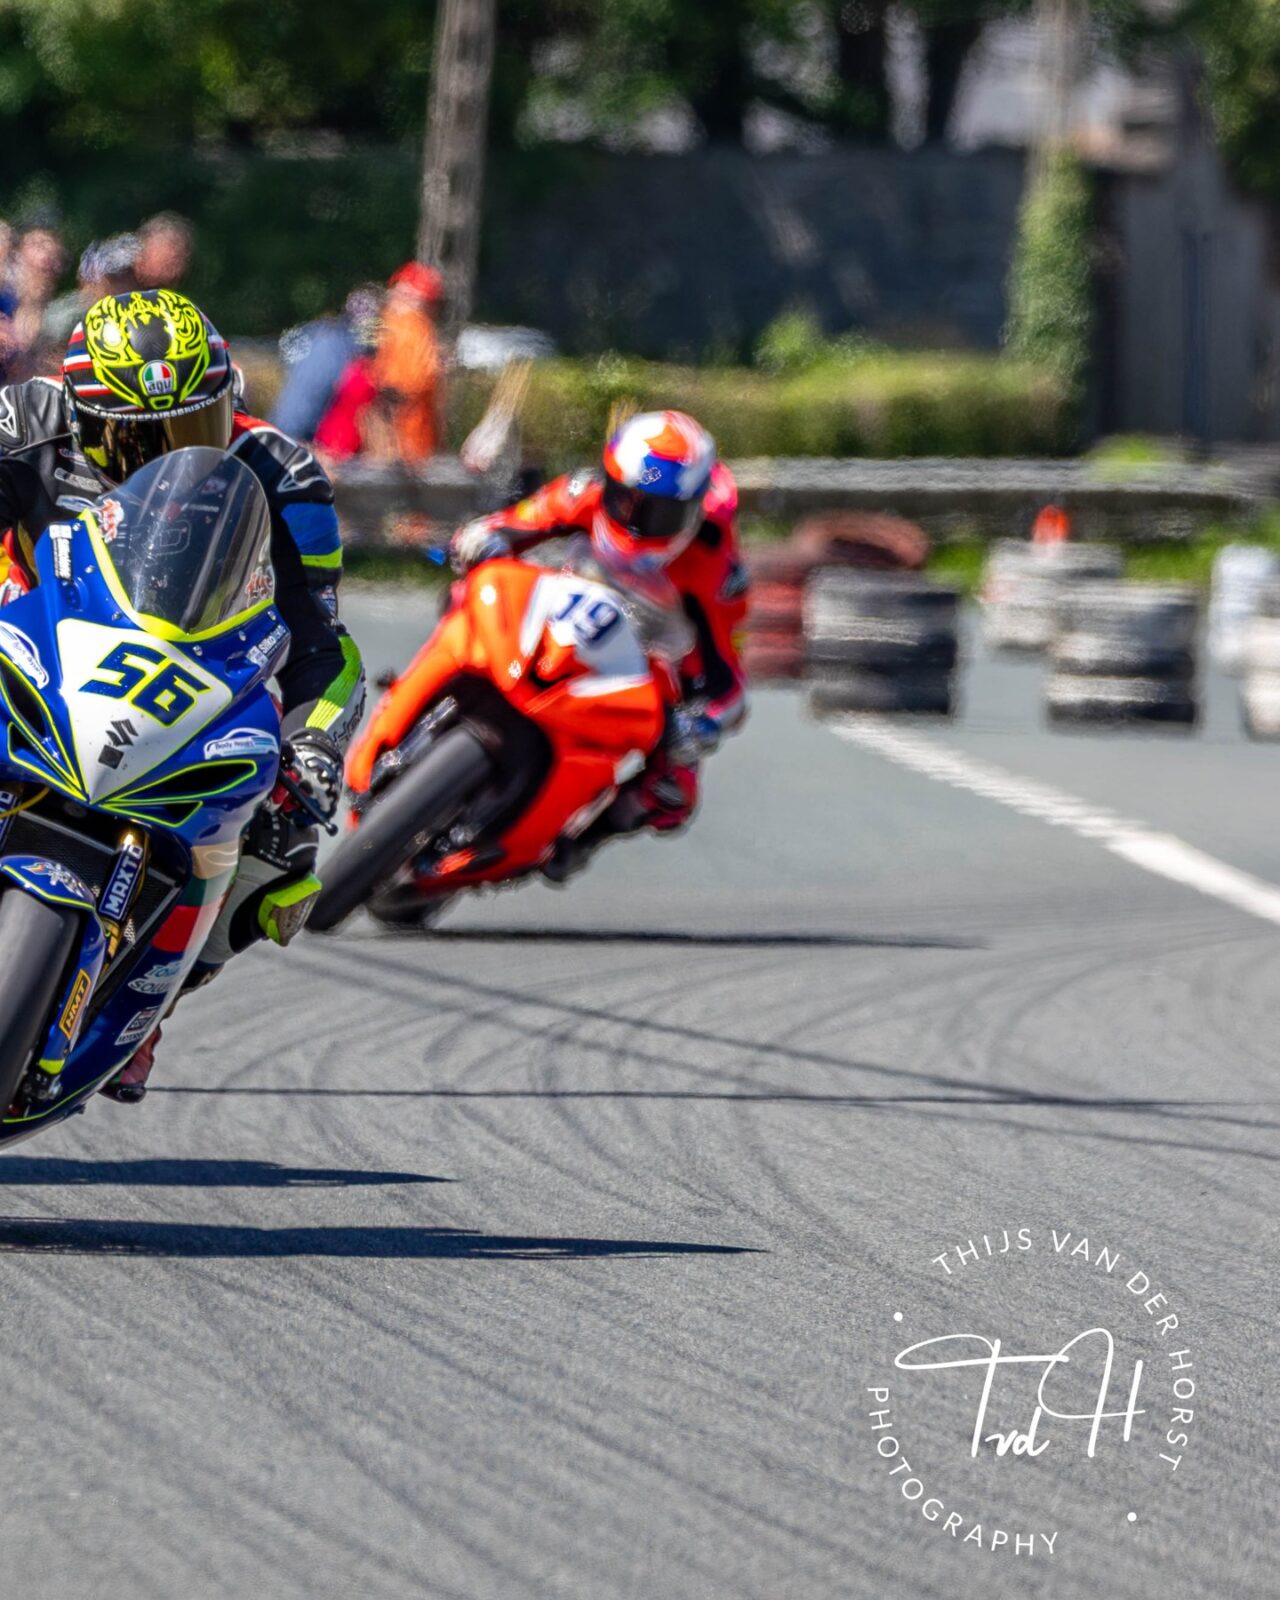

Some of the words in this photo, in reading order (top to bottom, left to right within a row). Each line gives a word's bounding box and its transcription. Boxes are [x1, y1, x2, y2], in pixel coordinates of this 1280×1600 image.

[555, 592, 620, 643] 19
[79, 641, 212, 728] 56
[64, 977, 88, 1031] HMT
